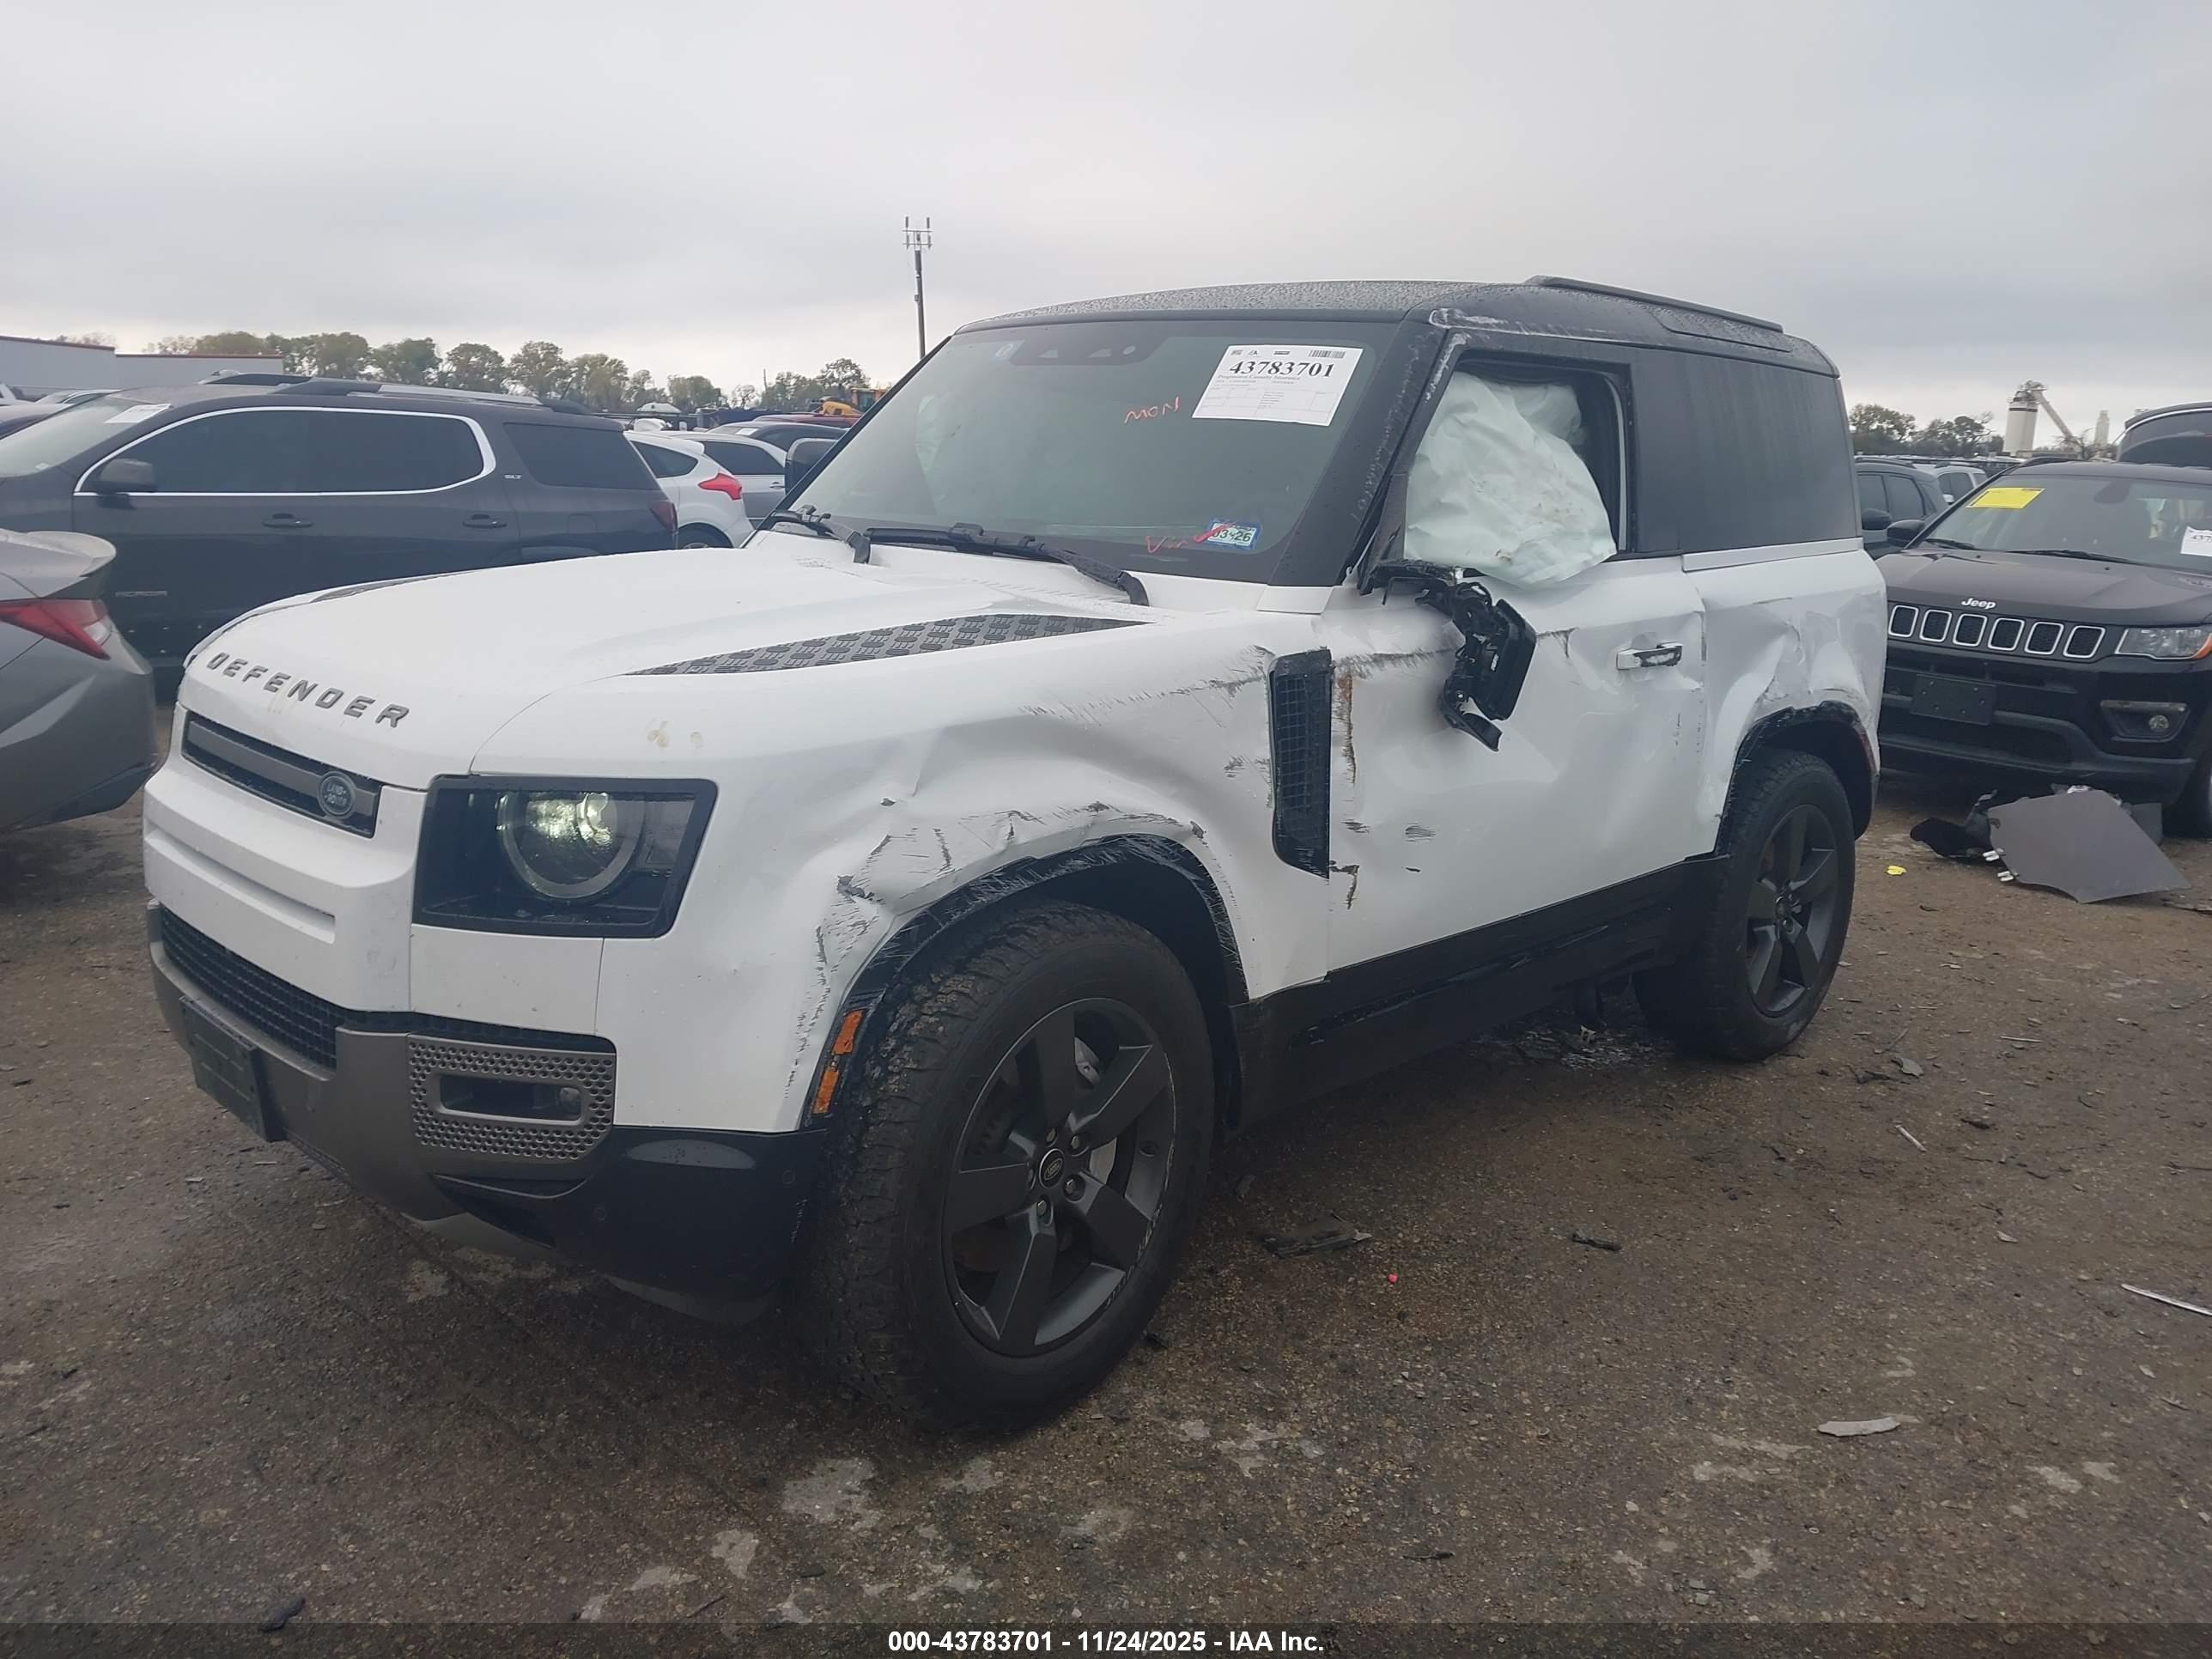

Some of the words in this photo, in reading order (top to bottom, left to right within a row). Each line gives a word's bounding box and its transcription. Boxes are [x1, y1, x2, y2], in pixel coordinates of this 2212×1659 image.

[1230, 361, 1334, 378] 43783701
[1961, 598, 1996, 609] Jeep
[206, 653, 410, 727] DEFENDER
